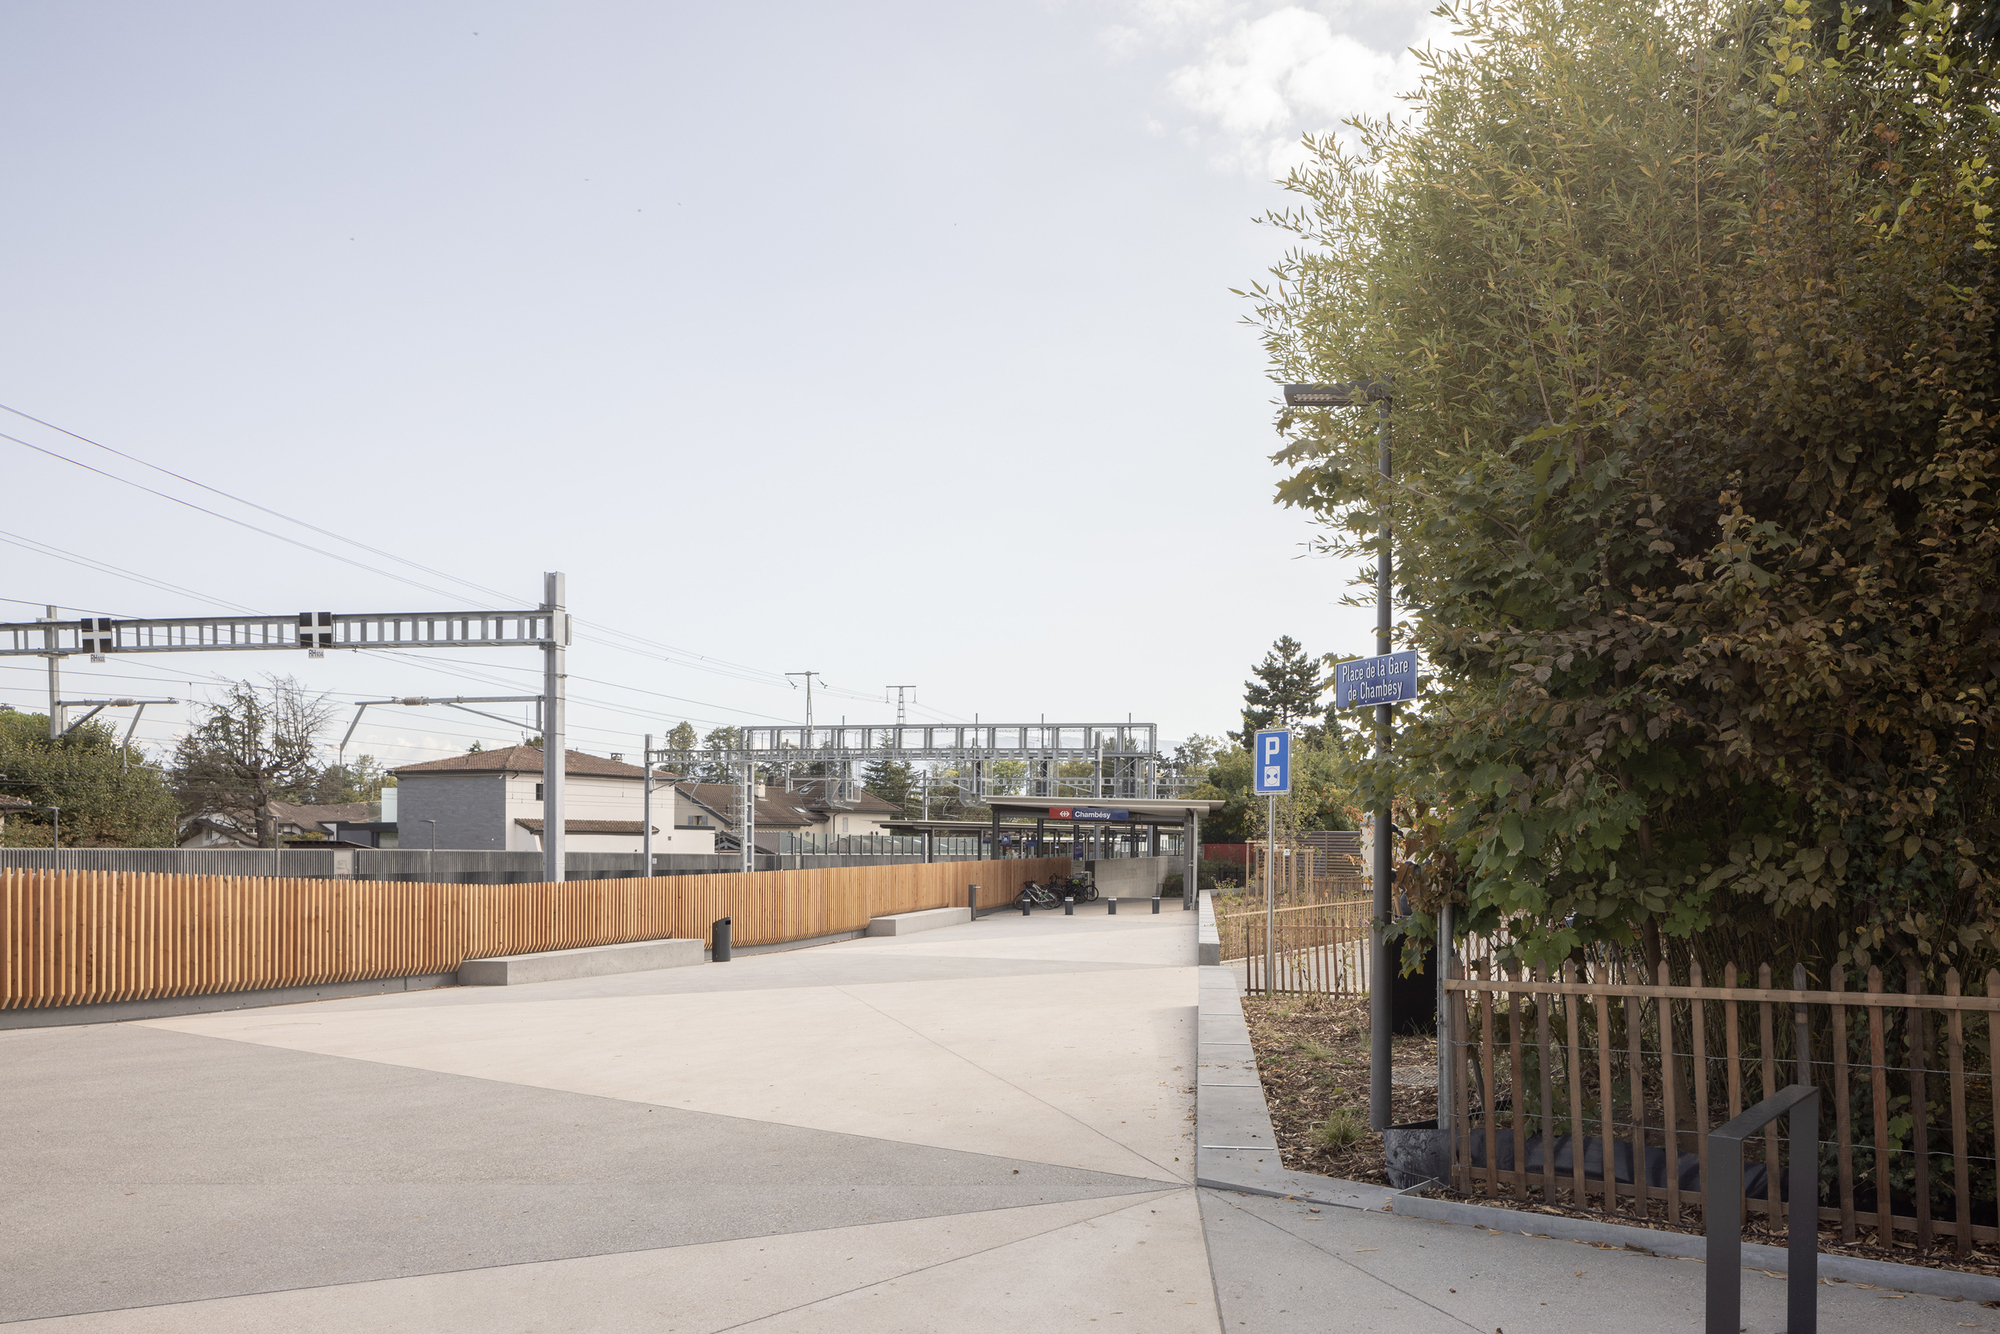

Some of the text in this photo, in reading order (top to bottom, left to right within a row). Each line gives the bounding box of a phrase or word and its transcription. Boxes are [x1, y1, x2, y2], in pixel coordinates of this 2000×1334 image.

[1342, 656, 1409, 683] Place de la Gare
[1347, 679, 1403, 701] de Chambésy
[1265, 736, 1280, 765] P
[1074, 810, 1111, 820] Chambésy
